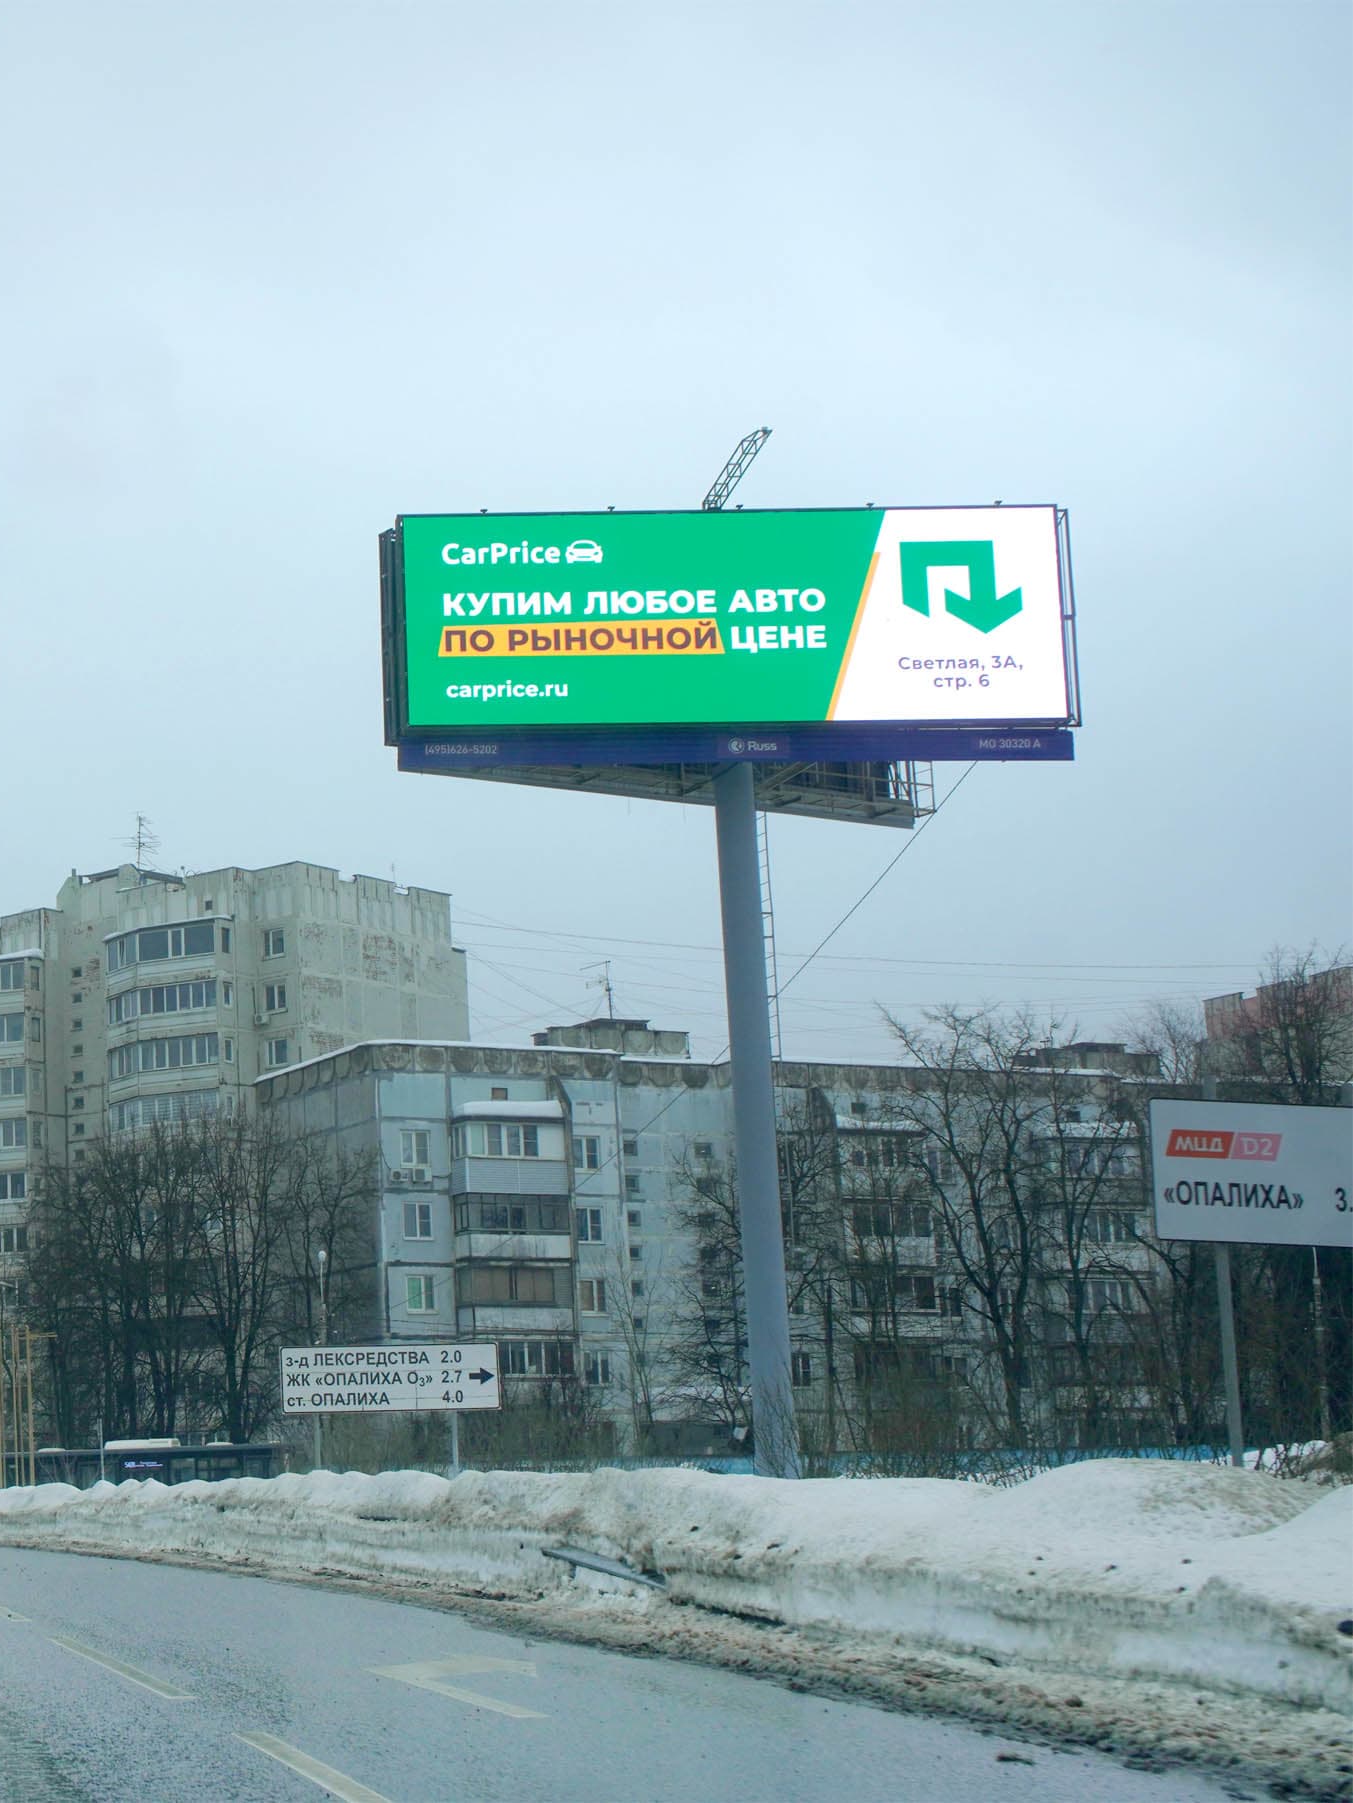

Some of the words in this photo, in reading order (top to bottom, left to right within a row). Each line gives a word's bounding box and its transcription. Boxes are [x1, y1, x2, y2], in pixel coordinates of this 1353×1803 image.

[442, 540, 561, 565] CarPrice
[443, 592, 572, 617] КУПИМ
[583, 590, 717, 615] ЛЮБОЕ
[728, 588, 826, 613] АВТО
[444, 629, 495, 652] ПО
[508, 620, 717, 651] РЫНОЧНОЙ
[730, 625, 827, 653] ЦЕНЕ
[897, 656, 985, 672] Светлая,
[445, 679, 569, 702] carprice.ru
[933, 676, 973, 691] стр.
[978, 674, 990, 688] 6
[747, 740, 778, 752] Russ
[1175, 1135, 1225, 1153] МЦД
[1241, 1137, 1274, 1156] D2
[1164, 1180, 1304, 1210] «ОПАЛИХА»
[313, 1350, 430, 1367] ЛЕКСРЕДСТВА
[440, 1350, 462, 1363] 2.0
[286, 1373, 311, 1387] ЖК
[315, 1370, 403, 1386] «ОПАЛИХА
[440, 1370, 463, 1384] 2.7
[287, 1396, 306, 1407] ст.
[311, 1391, 390, 1406] ОПАЛИХА
[442, 1389, 464, 1403] 4.0
